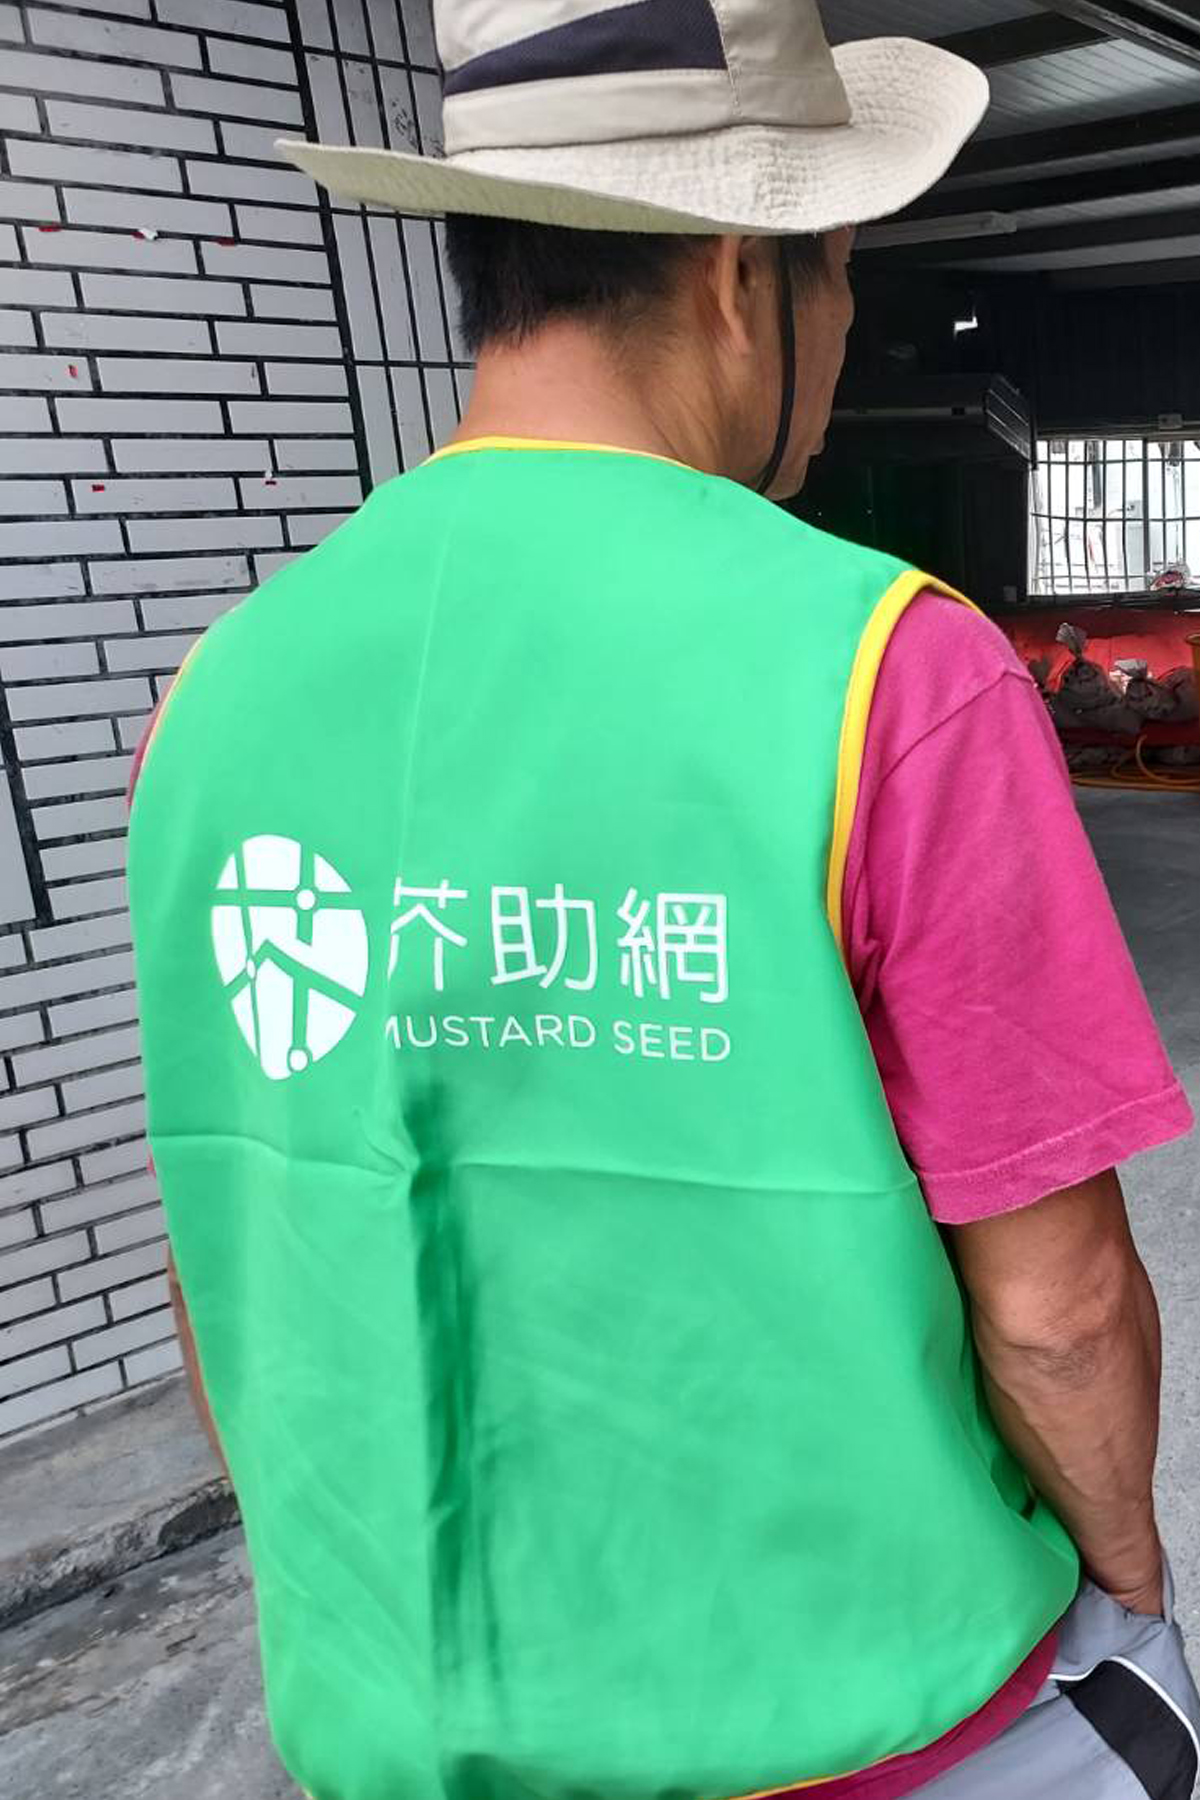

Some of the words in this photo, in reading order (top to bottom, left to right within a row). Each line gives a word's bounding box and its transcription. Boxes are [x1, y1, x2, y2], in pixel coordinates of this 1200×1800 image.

[386, 876, 730, 1003] 芥助網
[612, 1020, 732, 1062] SEED
